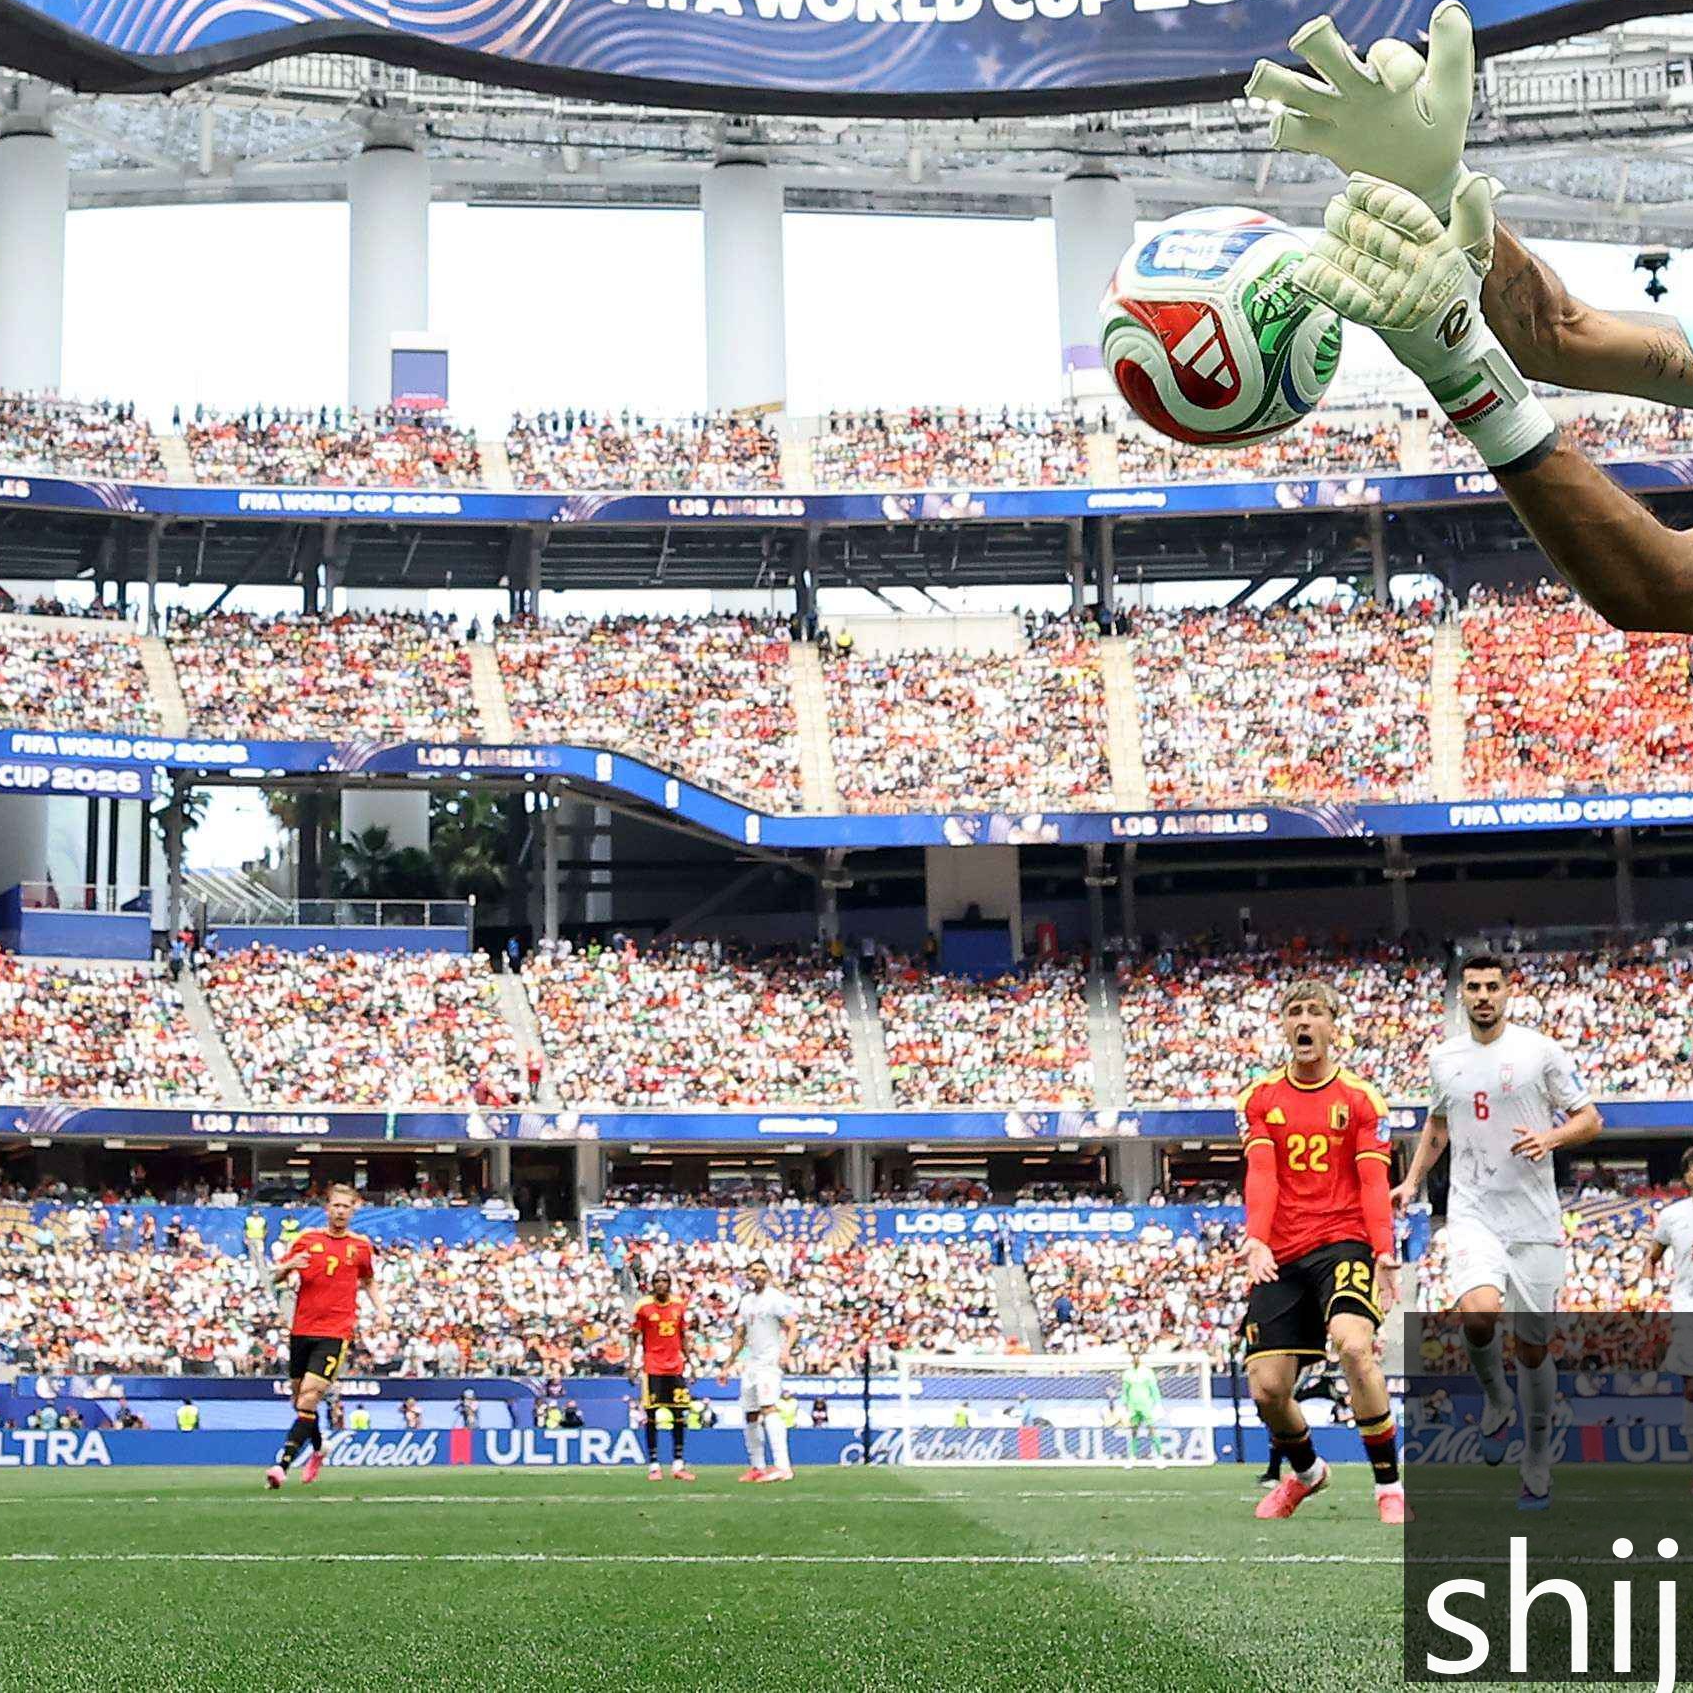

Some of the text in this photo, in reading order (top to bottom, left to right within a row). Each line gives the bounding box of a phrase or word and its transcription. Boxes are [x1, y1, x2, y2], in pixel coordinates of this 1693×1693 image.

[1455, 474, 1499, 494] LOS
[238, 493, 284, 512] FIFA
[351, 495, 392, 514] CUP
[667, 499, 709, 517] LOS
[11, 734, 58, 755] FIFA
[58, 736, 132, 760] WORLD
[133, 740, 174, 761] CUP
[417, 748, 461, 767] LOS
[0, 763, 49, 789] CUP
[50, 767, 142, 793] 2026
[1450, 805, 1500, 827] FIFA
[1501, 801, 1585, 824] WORLD
[1586, 799, 1631, 821] CUP
[1111, 818, 1158, 838] LOS
[1473, 1090, 1490, 1122] 6
[191, 1113, 233, 1133] LOS
[1286, 1133, 1330, 1173] 22
[895, 1213, 967, 1234] LOS
[1333, 1259, 1372, 1293] 22
[484, 1428, 647, 1466] ULTRA
